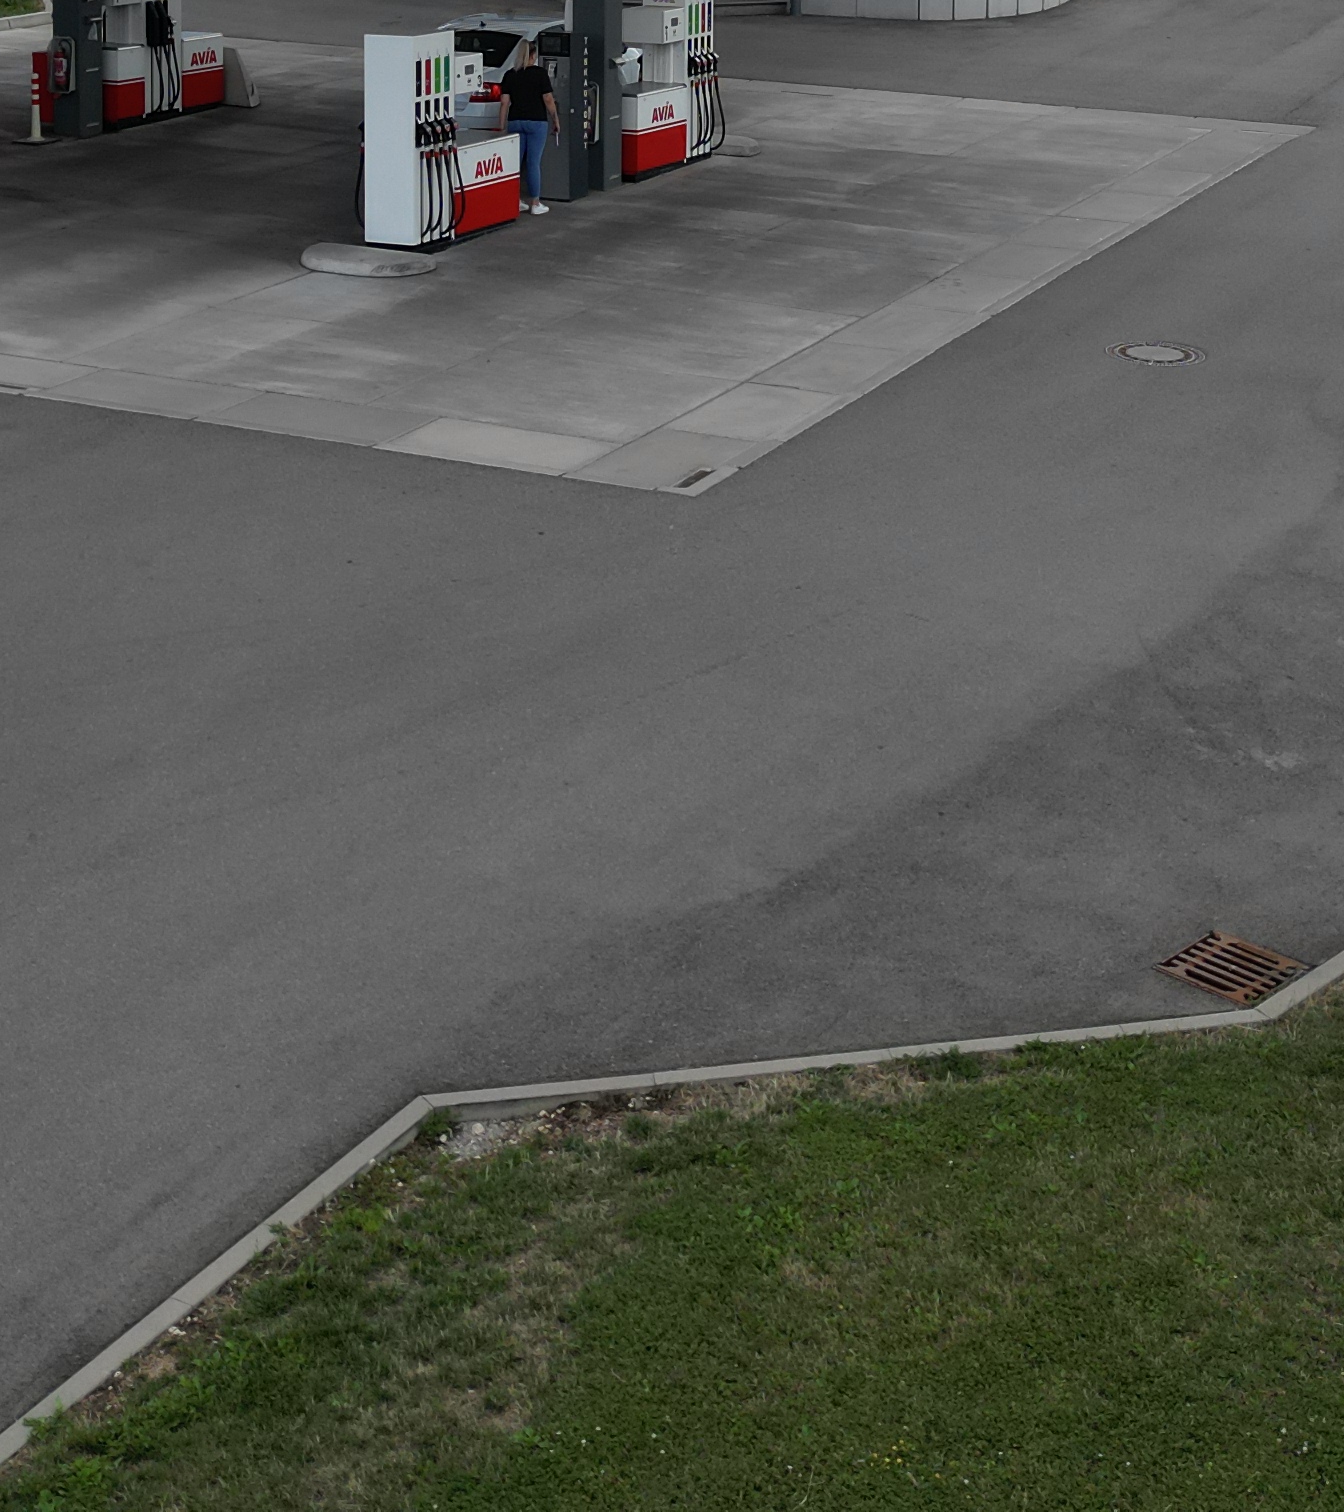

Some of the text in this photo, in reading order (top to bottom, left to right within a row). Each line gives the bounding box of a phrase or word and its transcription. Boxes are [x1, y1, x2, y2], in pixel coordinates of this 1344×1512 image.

[190, 46, 218, 67] AVIA
[651, 101, 675, 123] AVIA
[475, 153, 504, 179] AVIA
